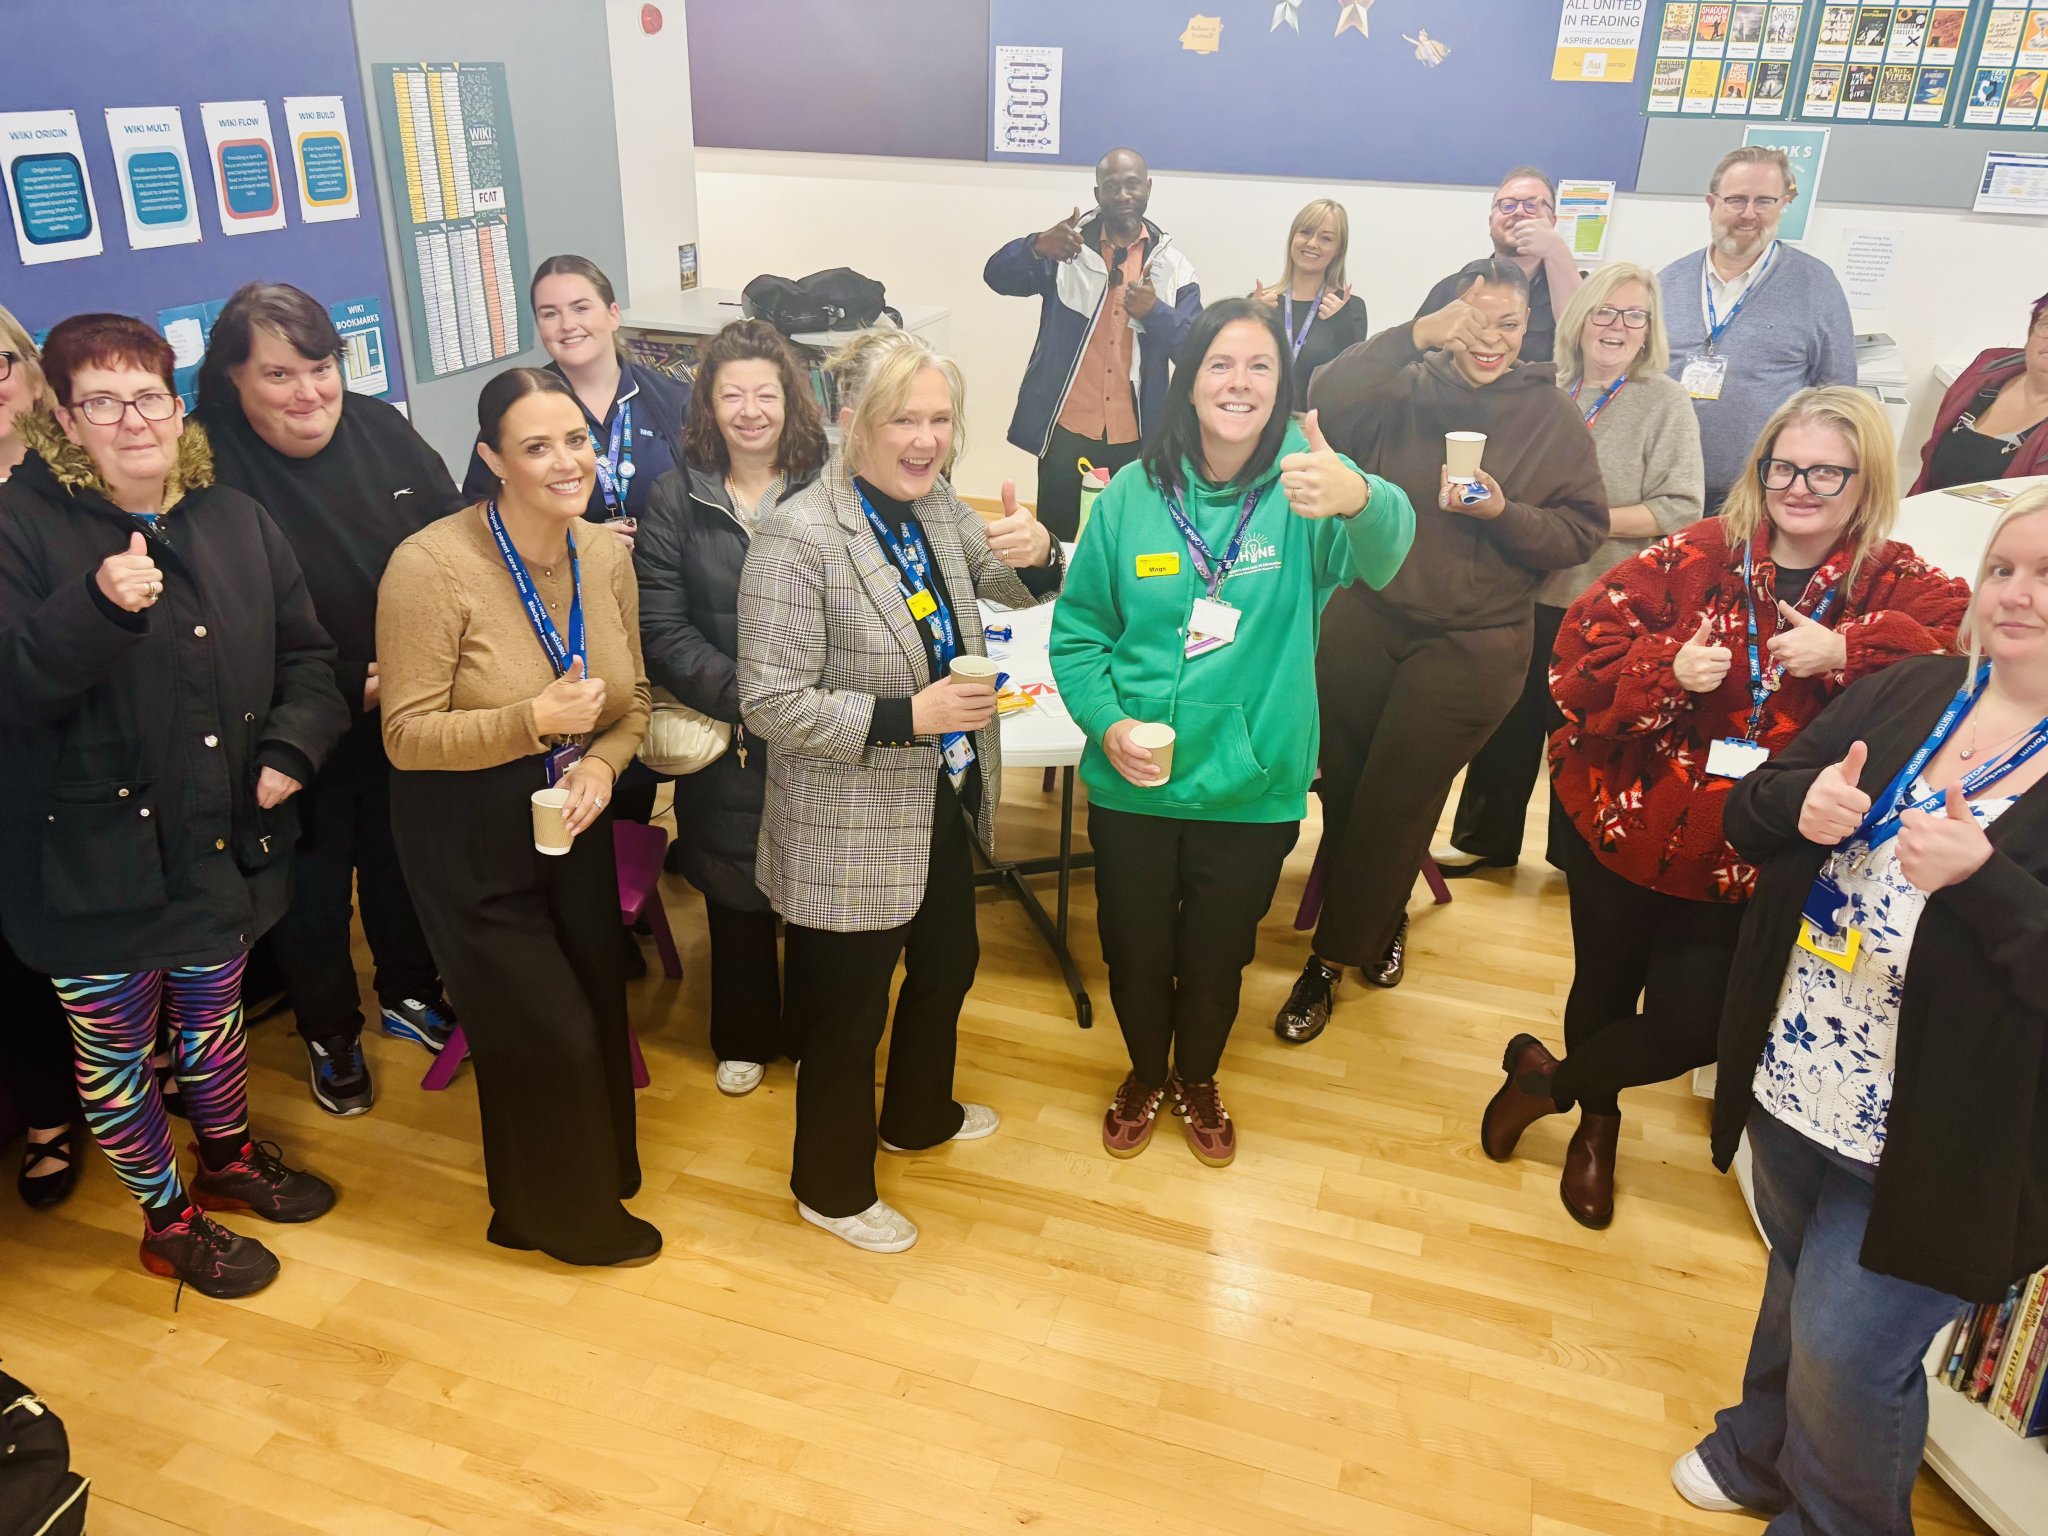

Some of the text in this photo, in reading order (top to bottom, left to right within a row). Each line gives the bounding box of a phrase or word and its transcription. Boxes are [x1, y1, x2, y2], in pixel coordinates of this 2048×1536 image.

[1566, 0, 1641, 11] ALL UNITED
[1702, 6, 1728, 15] SHADOW
[1564, 15, 1640, 27] IN READING
[1563, 37, 1634, 46] ASPIRE ACADEMY
[1730, 71, 1752, 80] RISE
[1885, 72, 1912, 81] VIPERS
[218, 118, 259, 127] WIKI FLOW
[298, 111, 335, 120] WIKI BUILD
[9, 129, 68, 140] WIKI ORIGIN
[123, 124, 170, 133] WIKI MULTI
[469, 127, 492, 141] WIKI
[479, 191, 497, 203] FCAT
[347, 304, 365, 315] WIKI
[335, 314, 380, 330] BOOKMARKS
[870, 511, 888, 535] VISITOR
[1185, 526, 1203, 546] Catholic
[891, 543, 910, 570] VISITOR
[915, 538, 927, 565] VISITOR
[495, 531, 510, 555] parent
[507, 553, 518, 571] carer
[516, 571, 528, 594] forum
[1194, 561, 1209, 579] FCAT
[1816, 598, 1830, 615] NHS
[527, 600, 545, 635] Blackpool
[944, 619, 954, 647] VISITOR
[550, 630, 567, 659] VISITOR
[1751, 658, 1759, 676] NHS
[1933, 710, 1956, 738] VISITOR
[2019, 734, 2047, 757] forum
[1905, 747, 1931, 776] VISITOR
[1961, 764, 1988, 786] SITOR
[1969, 763, 2013, 791] Blackpool
